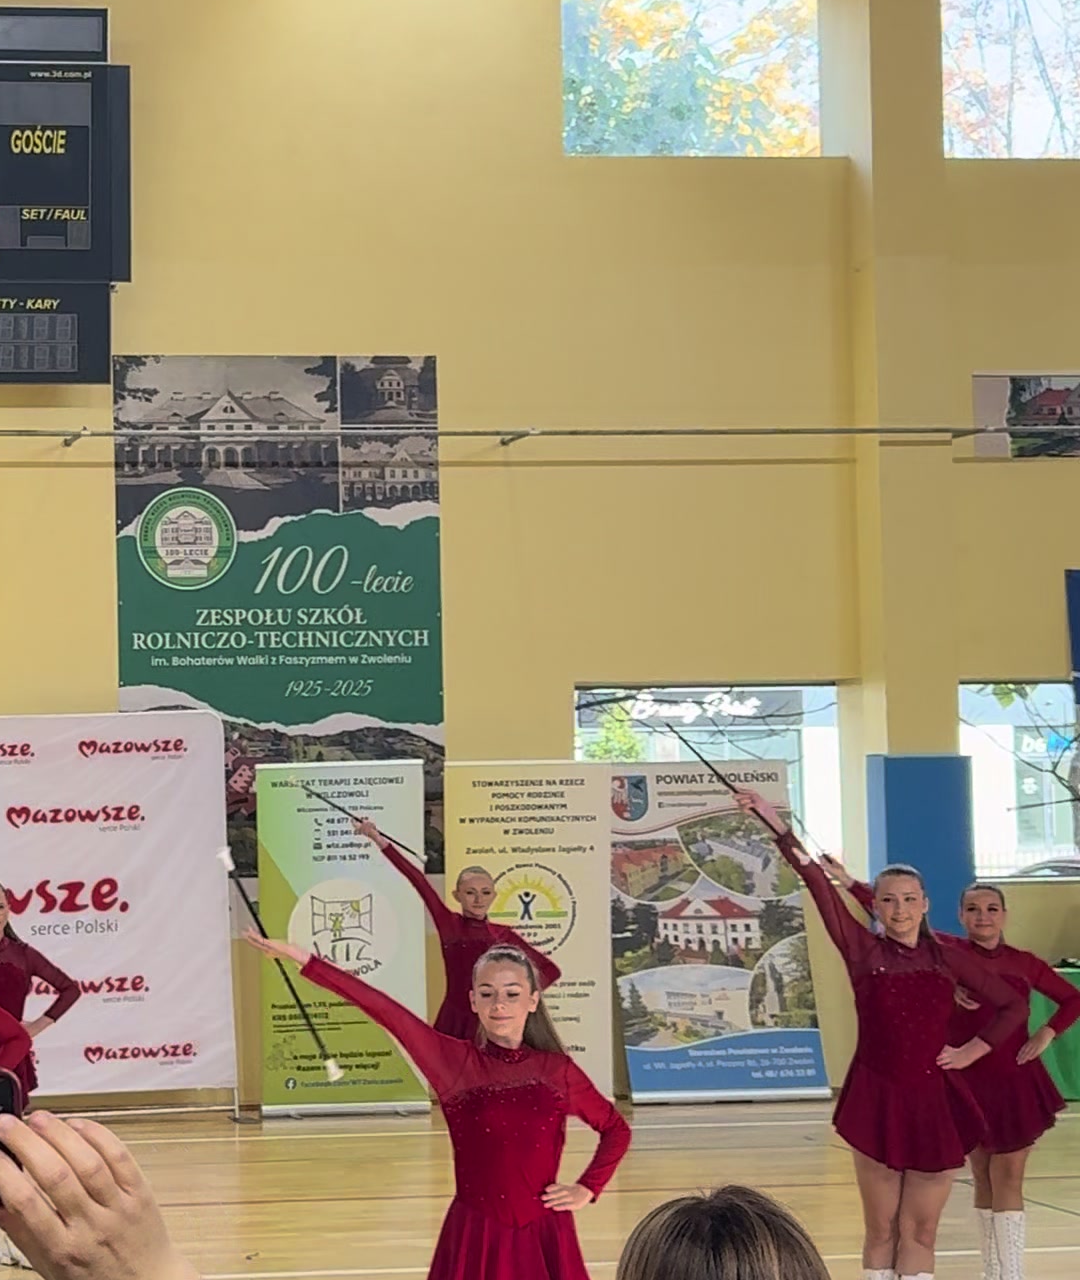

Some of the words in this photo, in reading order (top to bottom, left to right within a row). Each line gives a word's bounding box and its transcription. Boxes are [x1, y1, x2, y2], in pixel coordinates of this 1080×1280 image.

[10, 125, 67, 154] GOŚCIE
[26, 298, 60, 310] KARY
[195, 607, 292, 627] ZESPOŁU
[296, 604, 367, 626] SZKÓŁ
[132, 629, 430, 650] ROLNICZO-TECHNICZNYCH
[151, 656, 170, 667] im.
[171, 655, 234, 667] Bohaterów
[236, 654, 269, 666] Walki
[271, 657, 277, 666] z
[279, 654, 346, 668] Faszyzmem
[348, 656, 359, 665] w
[360, 653, 412, 665] Zwoleniu
[284, 679, 374, 698] 1925-2025
[320, 778, 351, 786] TERAPII
[353, 776, 405, 787] ZAJĘCIOWEJ
[472, 779, 544, 788] STOWARZYSZENIE
[559, 778, 585, 786] RZECZ
[655, 774, 705, 785] POWIAT
[491, 791, 525, 799] POMOCY
[526, 791, 565, 799] RODZINIE
[495, 803, 567, 811] POSZKODOWANYM
[469, 816, 517, 824] WYPADKACH
[518, 815, 597, 823] KOMUNIKACYJNYCH
[512, 827, 554, 835] ZWOLENIU
[31, 923, 71, 936] serce
[75, 920, 119, 934] Polski
